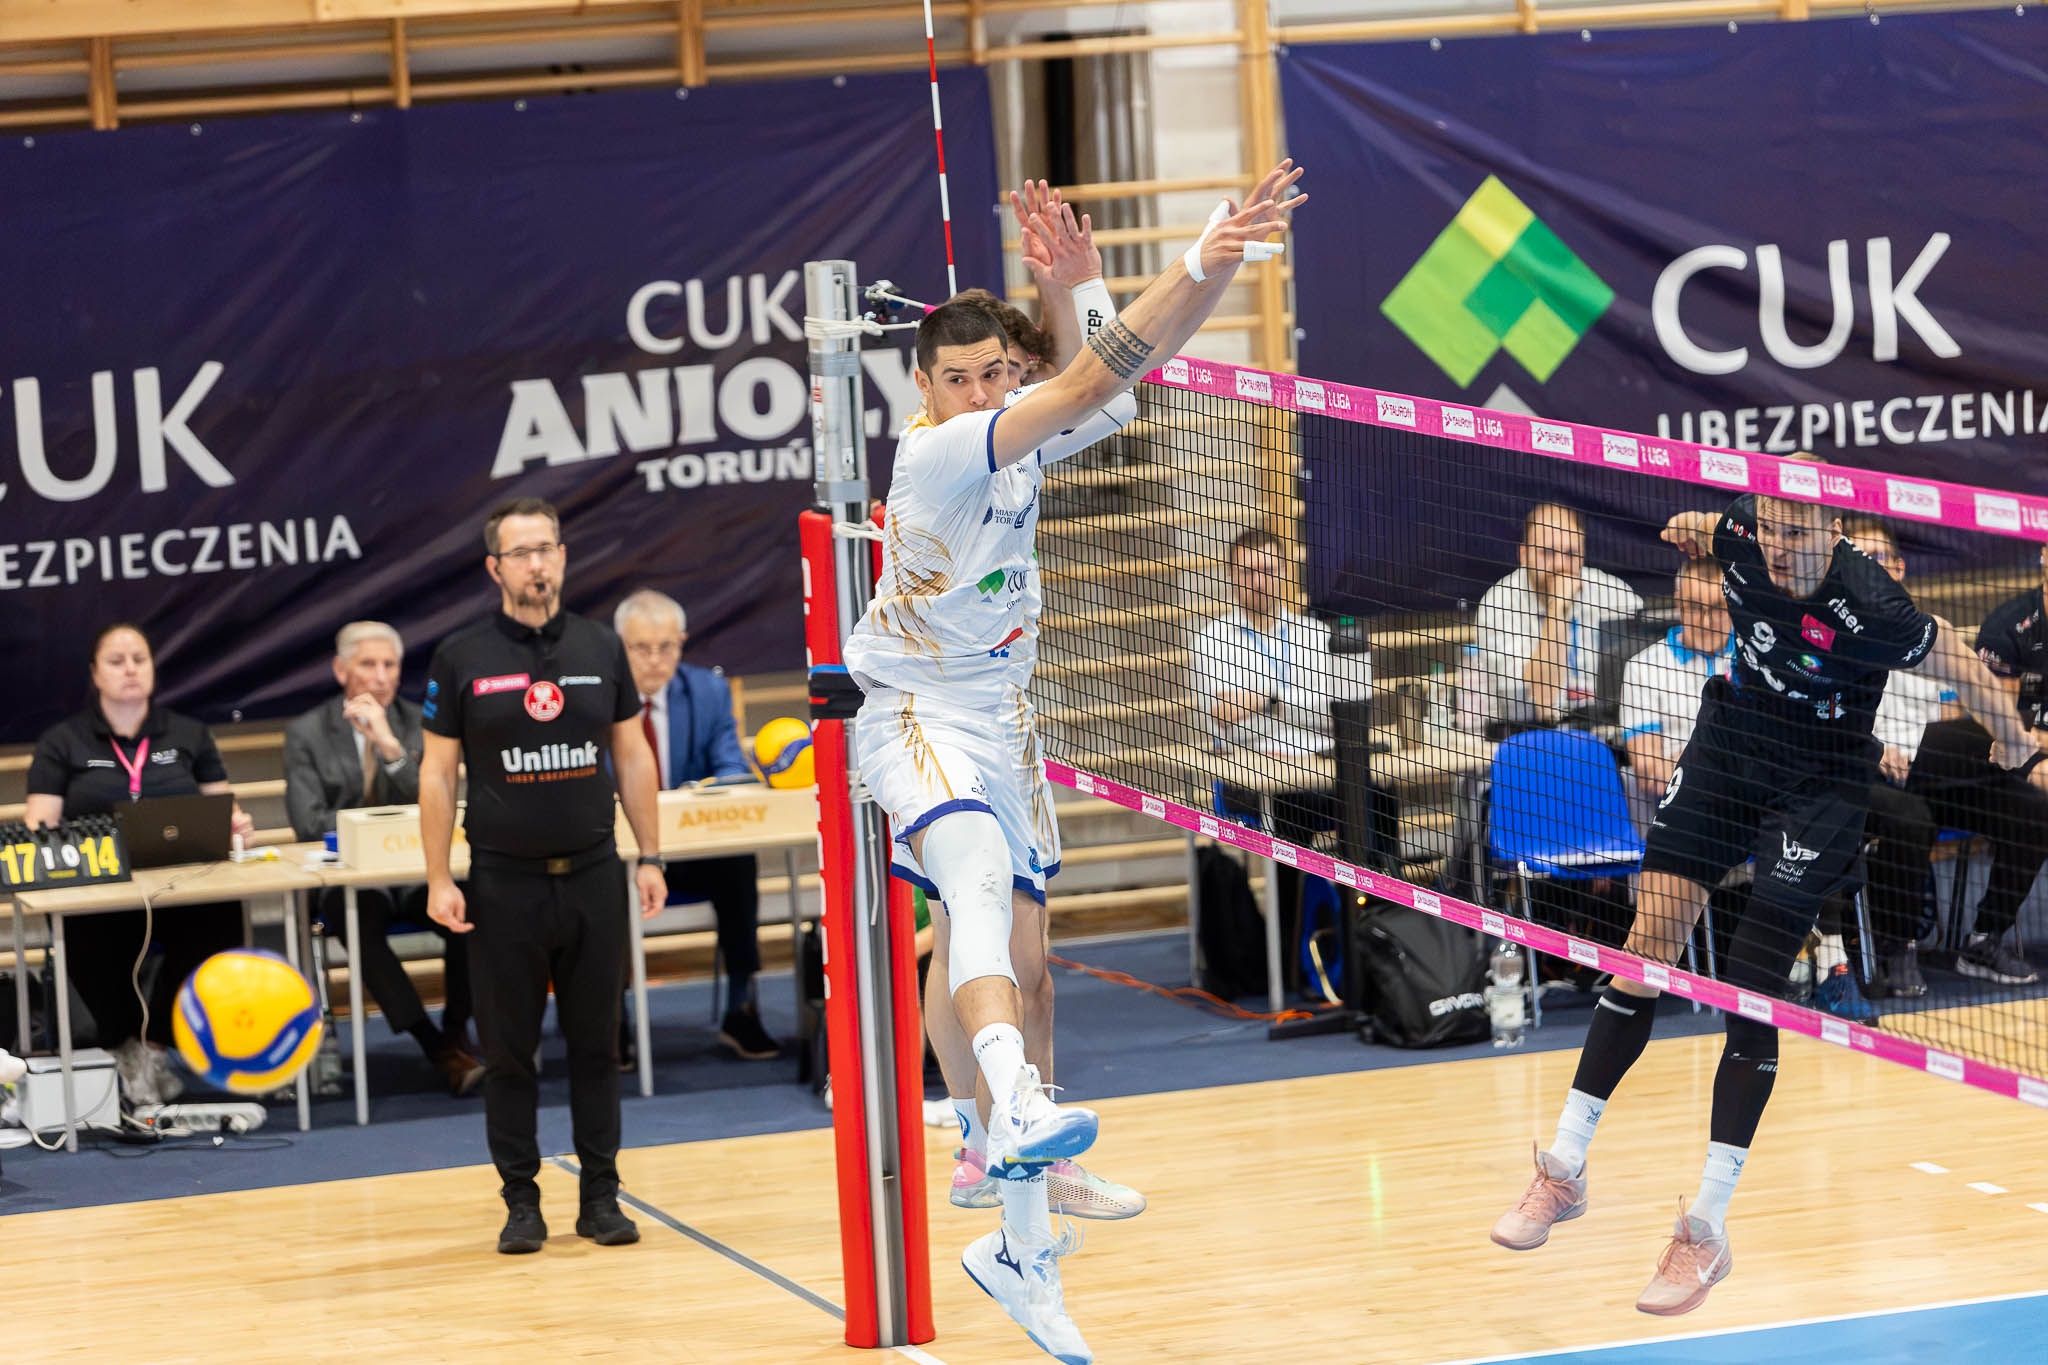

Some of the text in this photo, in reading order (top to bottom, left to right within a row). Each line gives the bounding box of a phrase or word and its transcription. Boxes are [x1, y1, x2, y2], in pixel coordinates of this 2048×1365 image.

[626, 269, 805, 354] CUK
[1652, 232, 1962, 375] CUK
[1196, 367, 1213, 385] LIGA
[1247, 378, 1268, 393] TAURON
[490, 346, 921, 478] ANIOY
[1333, 391, 1351, 411] LIGA
[1390, 403, 1412, 419] TAURON
[1657, 389, 2048, 453] UBEZPIECZENI
[0, 361, 236, 502] UK
[1483, 418, 1504, 438] LIGA
[637, 437, 813, 493] TORUŃ
[1828, 598, 1864, 634] riser
[501, 740, 599, 773] Unilink
[0, 835, 120, 885] 17 1 0 14
